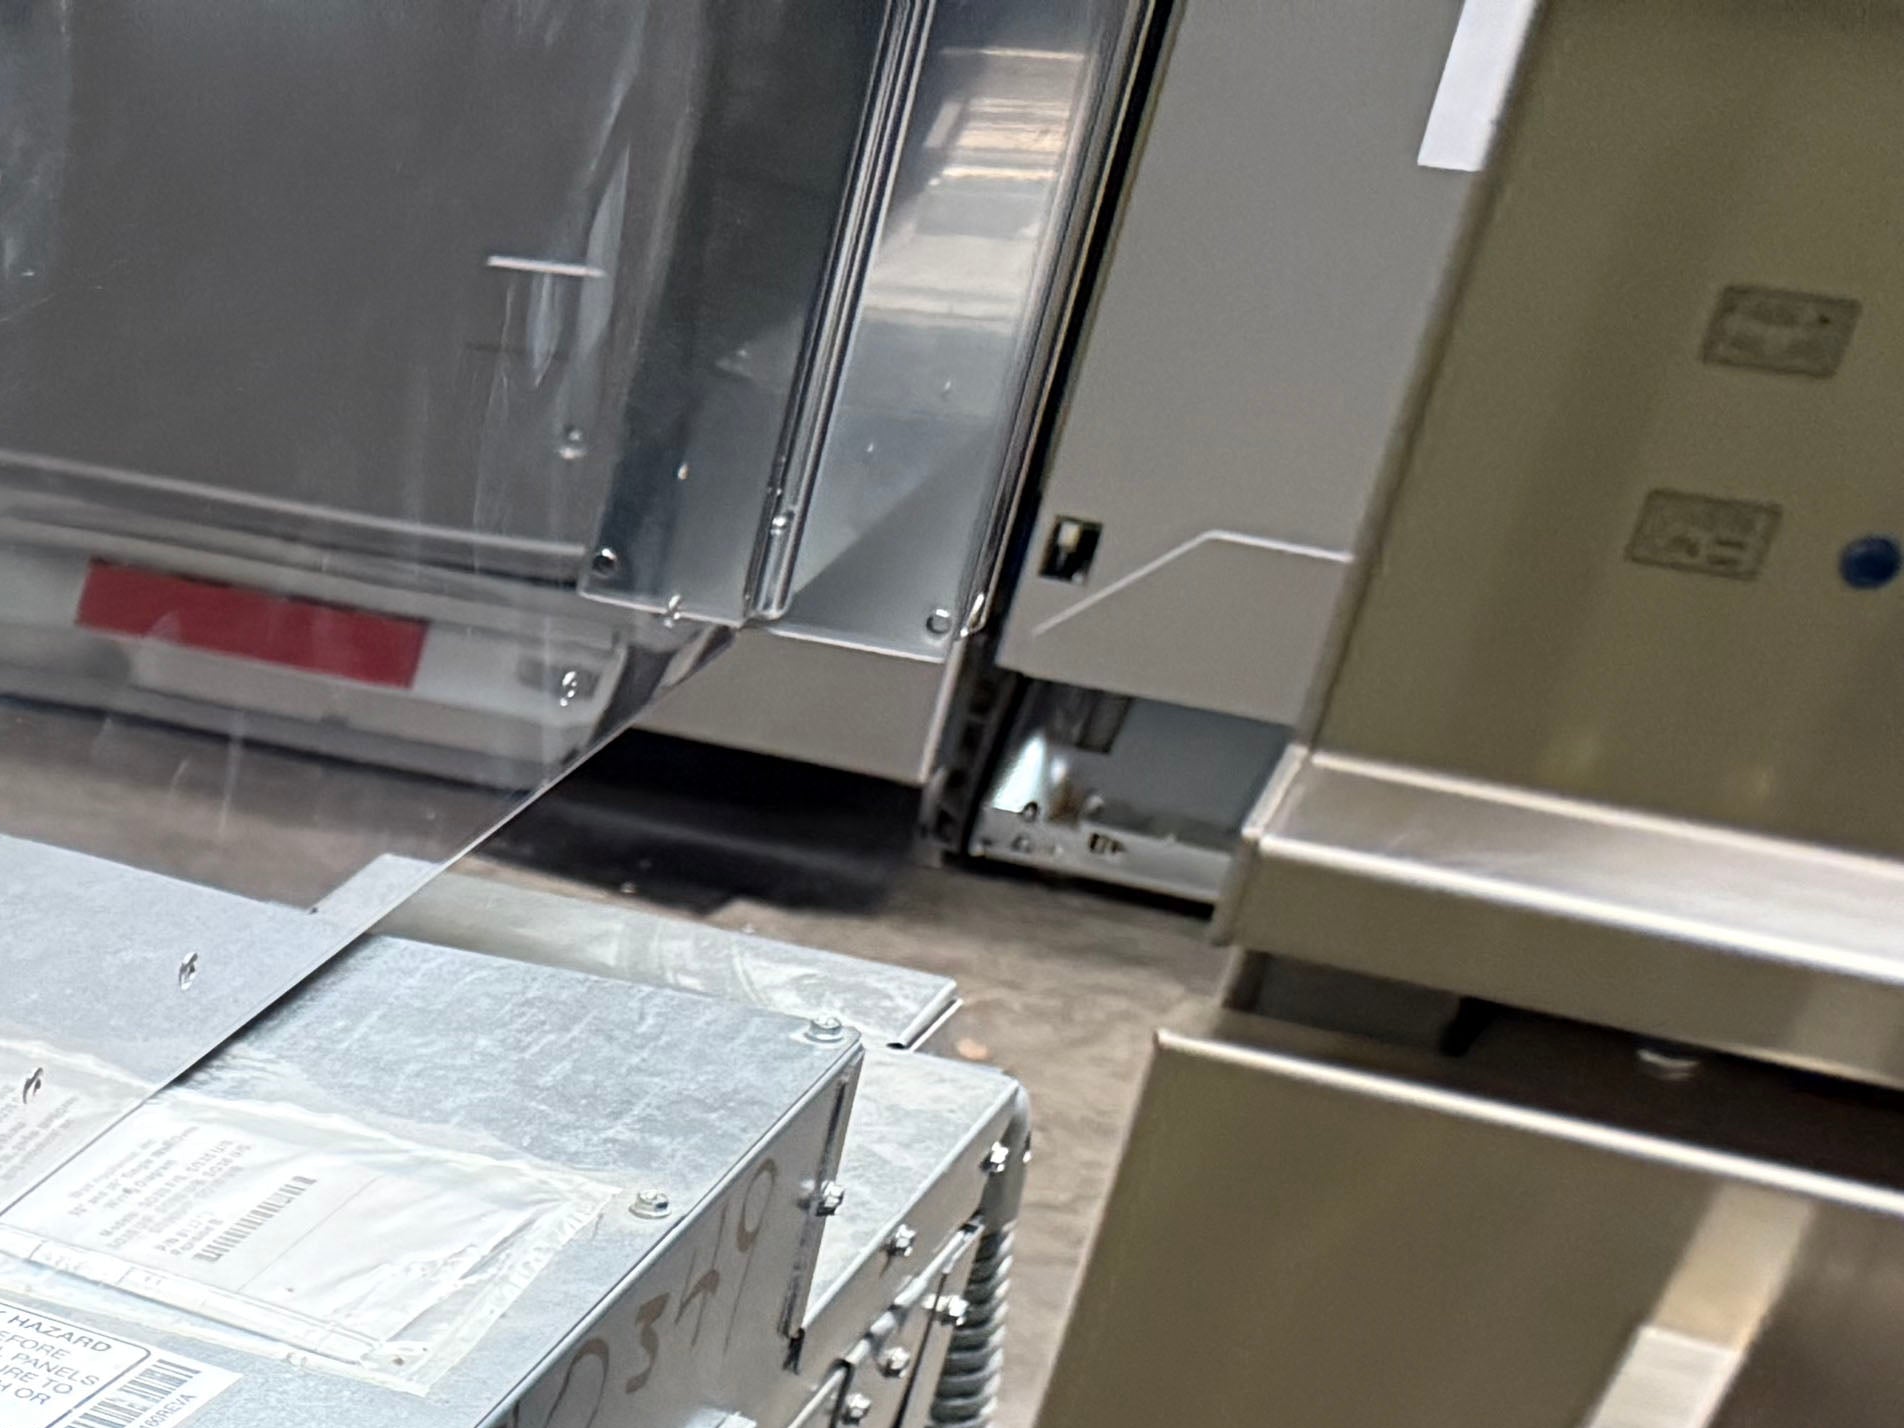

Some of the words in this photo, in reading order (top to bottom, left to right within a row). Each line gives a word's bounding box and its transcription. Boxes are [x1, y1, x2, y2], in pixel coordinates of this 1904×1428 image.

[9, 1314, 112, 1353] HAZARD
[10, 1351, 100, 1386] PANELS
[17, 1386, 51, 1406] OR
[42, 1376, 73, 1395] TO
